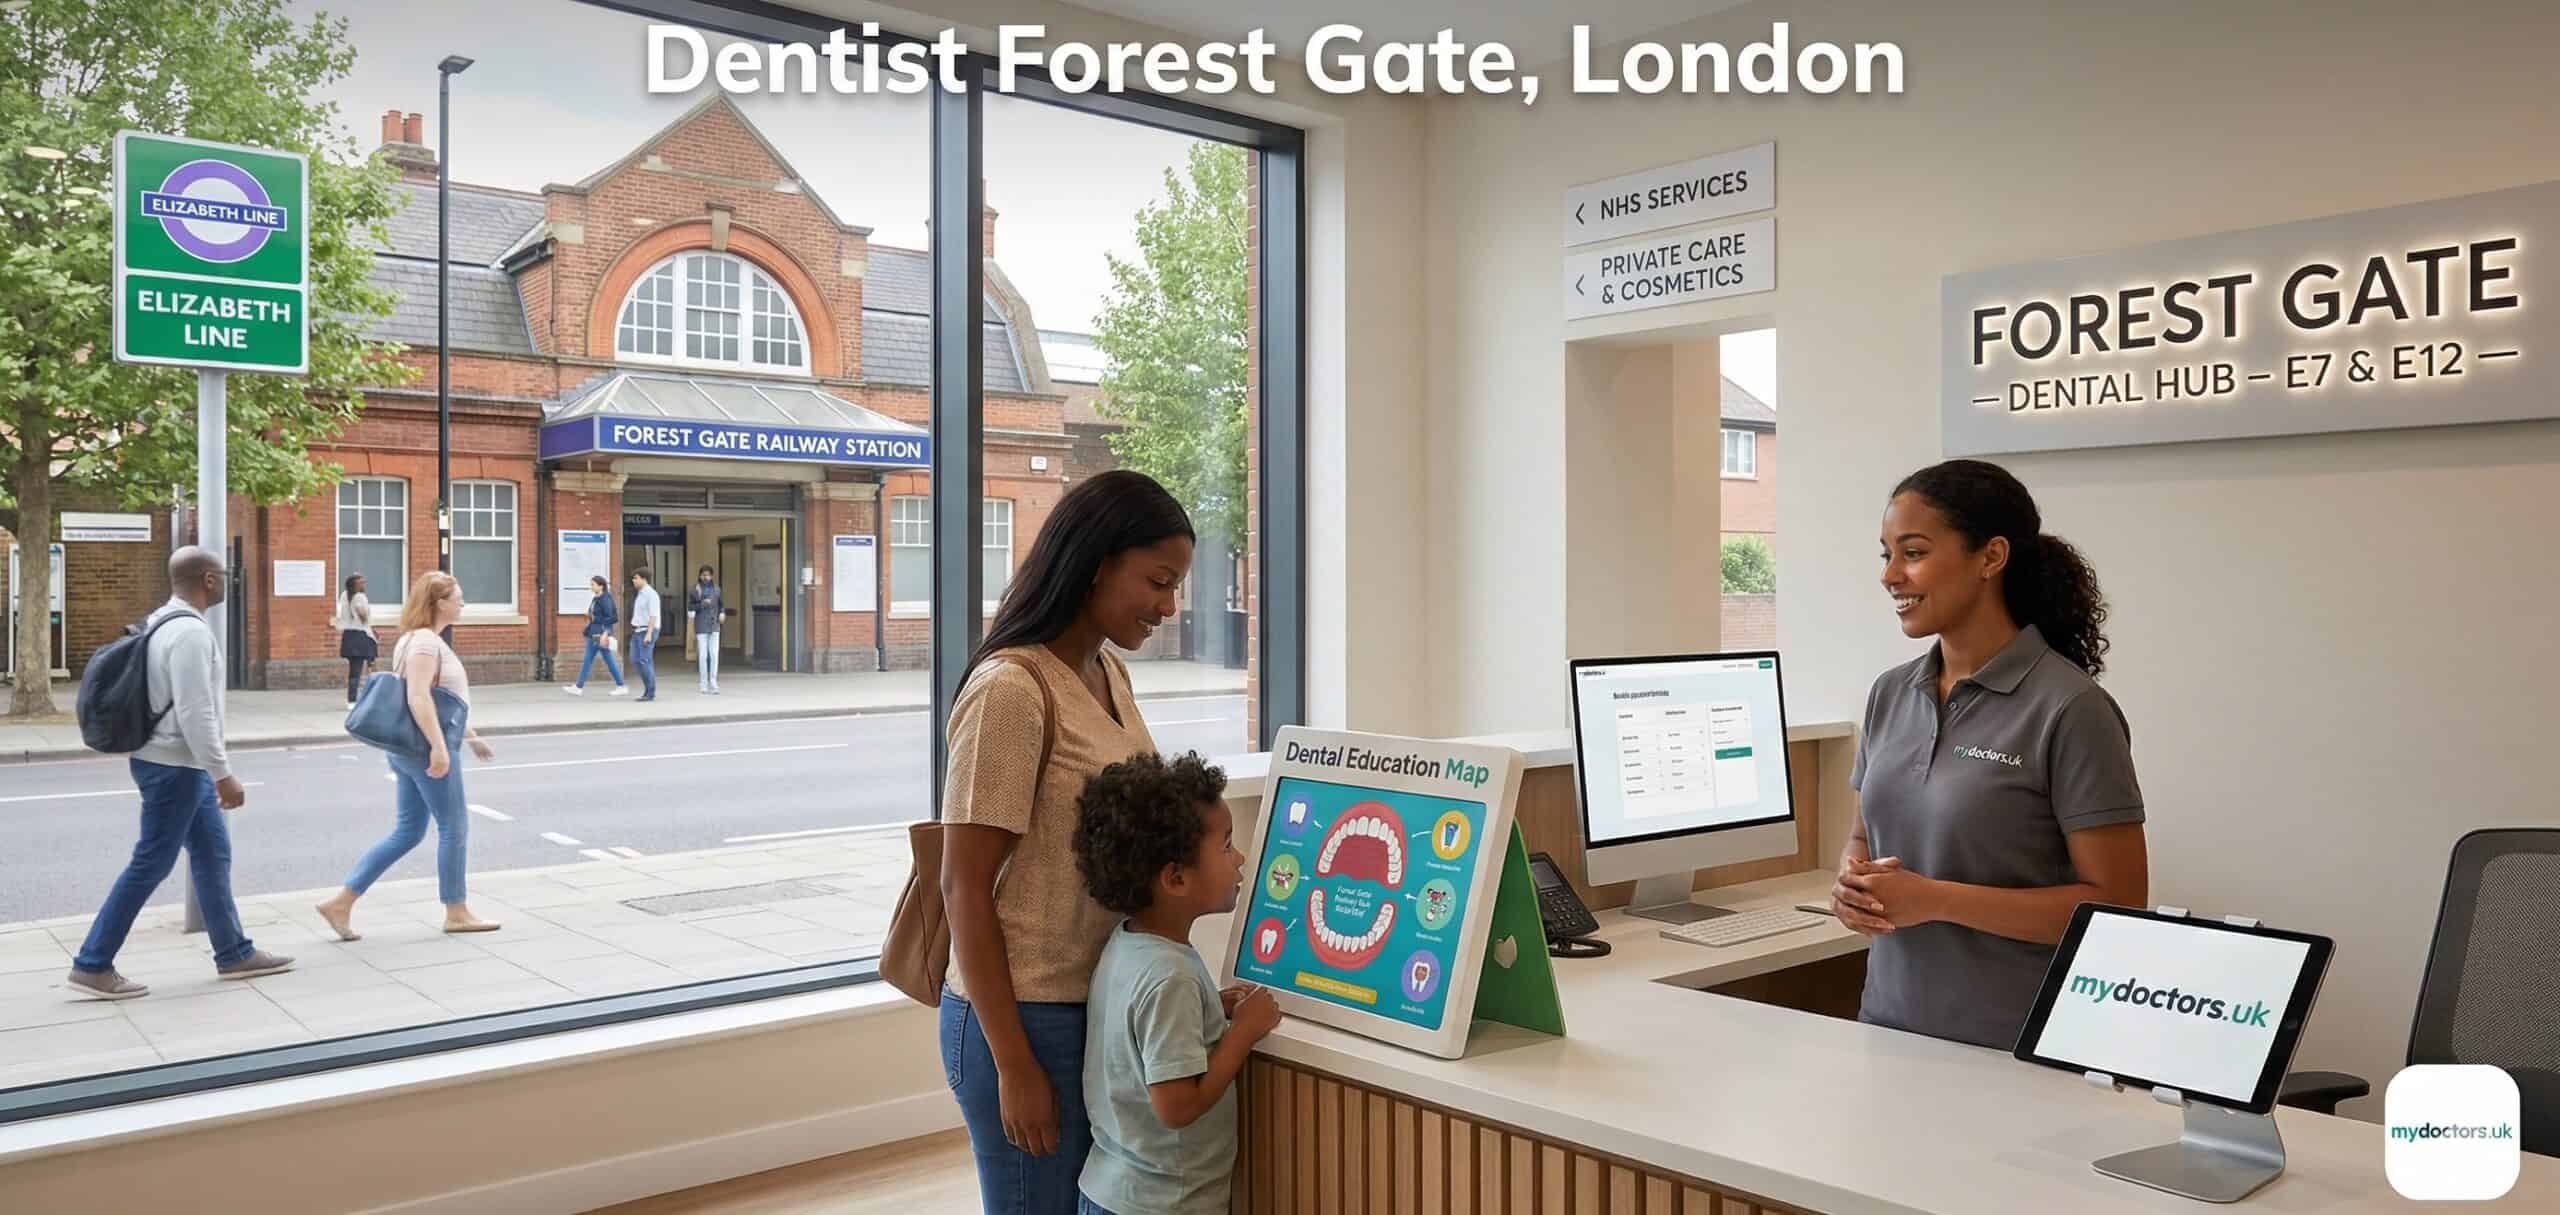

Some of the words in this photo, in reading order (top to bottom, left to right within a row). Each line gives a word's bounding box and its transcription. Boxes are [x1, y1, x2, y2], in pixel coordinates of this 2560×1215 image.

[152, 198, 239, 220] ELIZABETH
[243, 211, 279, 225] LINE
[1600, 193, 1641, 220] NHS
[1647, 170, 1748, 210] SERVICES
[1600, 244, 1682, 278] PRIVATE
[1688, 233, 1746, 262] CARE
[1601, 284, 1614, 305] &
[1621, 263, 1744, 301] COSMETICS
[1972, 273, 2253, 366] FOREST
[2281, 237, 2519, 331] GATE
[138, 290, 291, 324] ELIZABETH
[184, 324, 249, 349] LINE
[2008, 374, 2143, 412] DENTAL
[2155, 363, 2236, 401] HUB
[2286, 353, 2334, 389] E7
[2348, 350, 2375, 383] &
[2392, 342, 2464, 380] E12
[613, 424, 692, 447] FOREST
[698, 430, 751, 451] GATE
[756, 434, 840, 455] RAILWAY
[845, 438, 922, 459] STATION
[1285, 741, 1344, 769] Dental
[1346, 748, 1441, 779] Education
[1445, 758, 1490, 789] Map
[1953, 744, 2024, 769] mydoctors.uk
[2070, 973, 2273, 1030] mydoctors.uk
